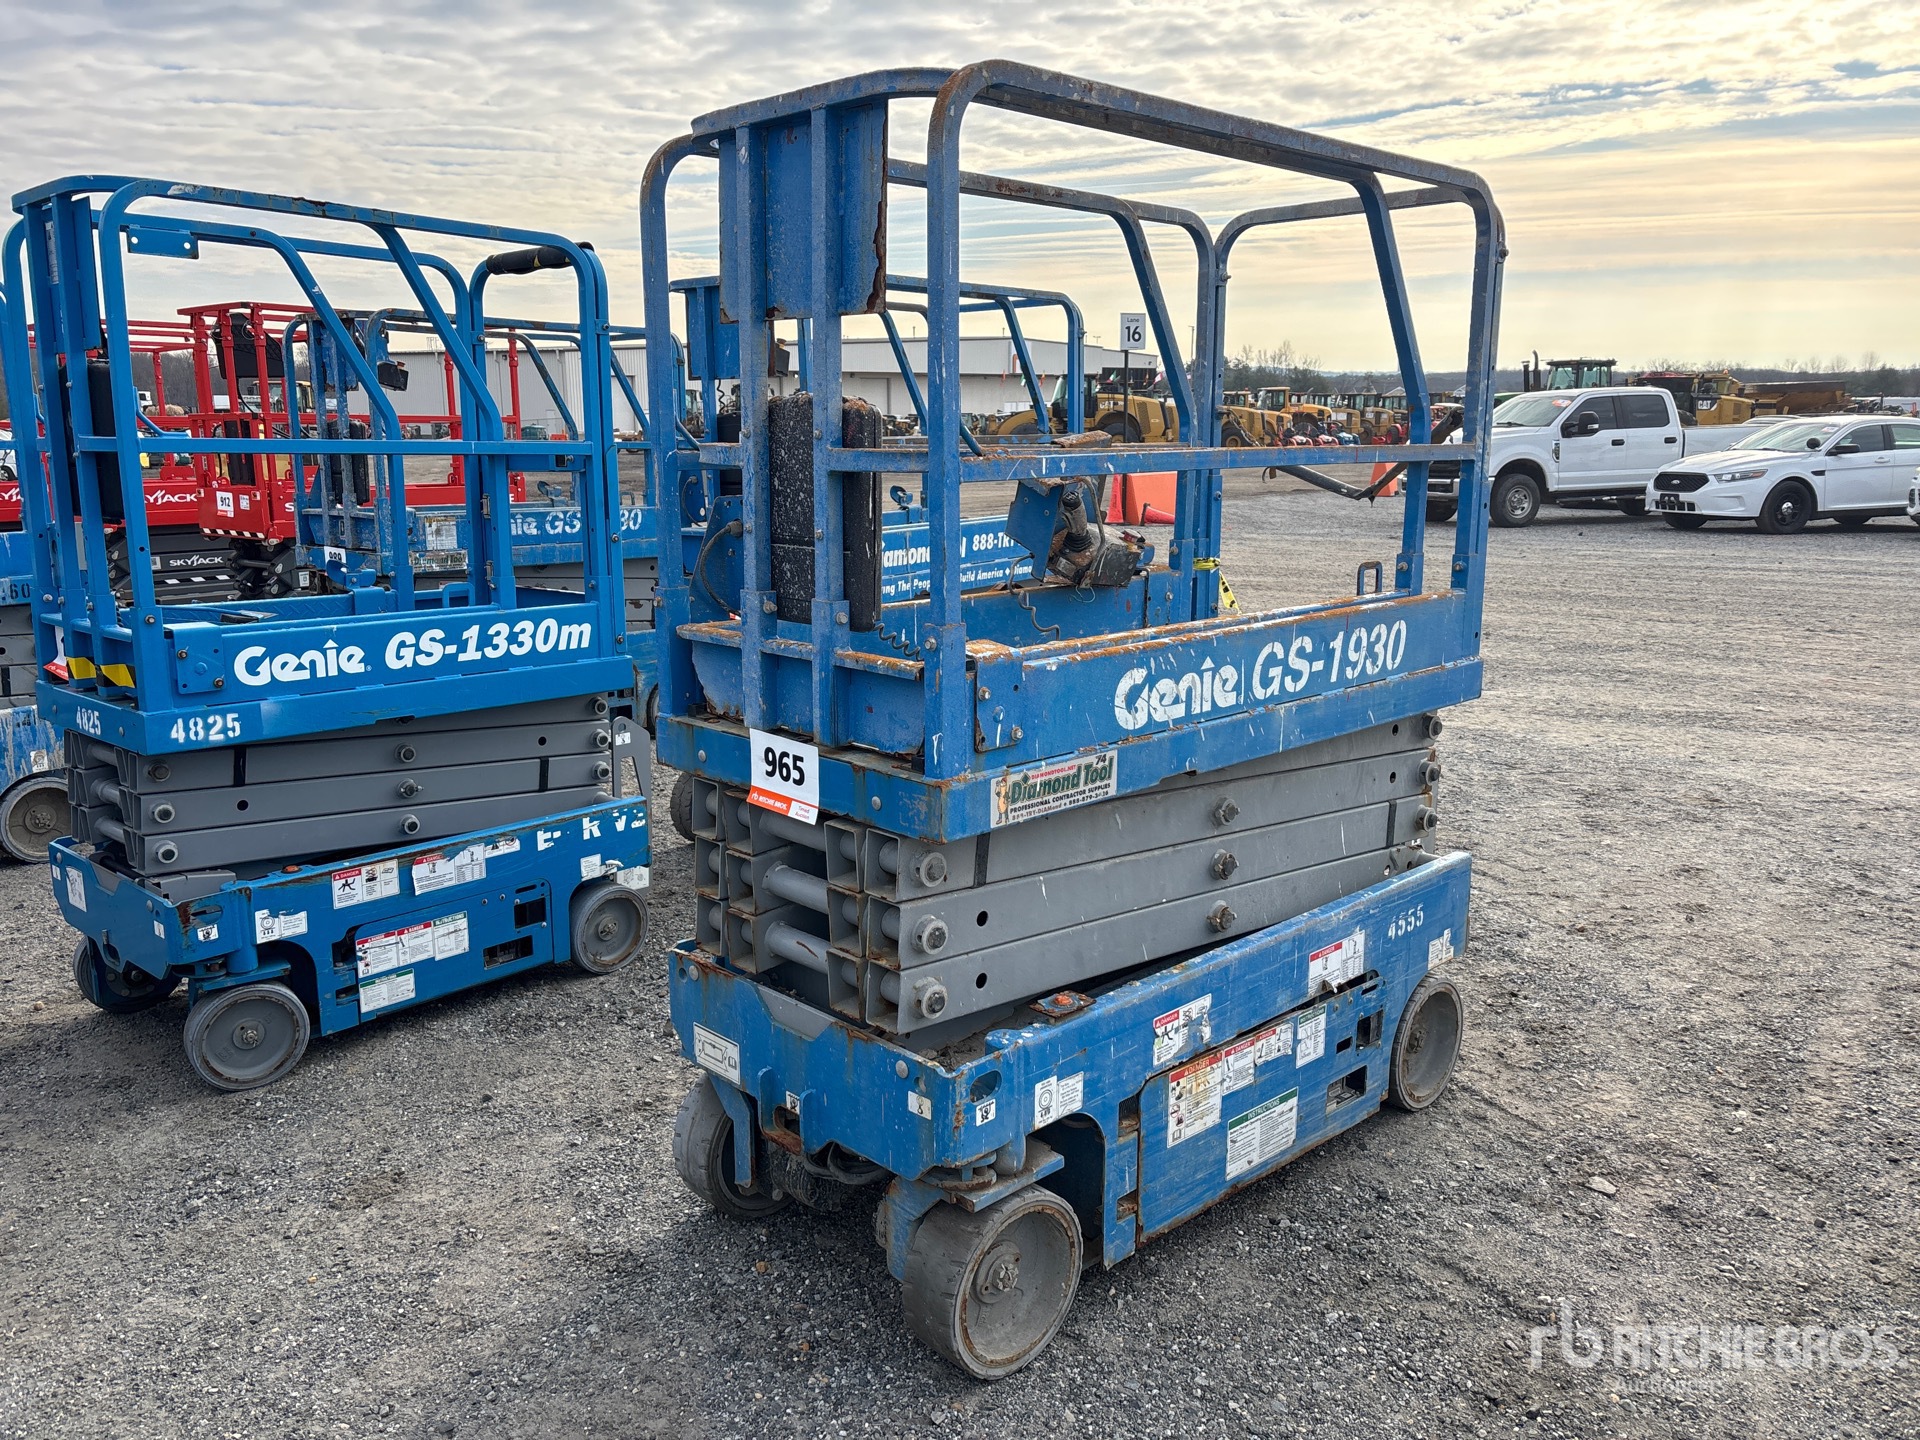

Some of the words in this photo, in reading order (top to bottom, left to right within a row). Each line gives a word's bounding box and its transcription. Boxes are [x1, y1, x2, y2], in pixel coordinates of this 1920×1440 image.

[1125, 326, 1142, 342] 16
[1698, 400, 1711, 410] CAT
[220, 496, 231, 508] 912
[169, 554, 224, 567] SKYJACK
[897, 579, 911, 592] The
[977, 567, 1004, 581] America
[234, 639, 366, 686] Genie
[385, 618, 592, 670] GS-1330m
[1114, 655, 1239, 730] Genie
[1252, 620, 1407, 700] GS-1930
[76, 705, 102, 736] 4825
[170, 713, 241, 744] 4825
[764, 746, 805, 787] 965
[1095, 753, 1107, 766] 74
[1010, 764, 1082, 805] Diamond
[1083, 756, 1115, 786] Tool
[1010, 799, 1051, 814] PROFESSIONAL
[1052, 788, 1087, 803] CONTRACTOR
[1088, 782, 1111, 794] SUPPLIES
[340, 870, 360, 879] DANGER
[1388, 902, 1425, 940] 4555
[1160, 1013, 1178, 1026] DANGER
[1235, 1041, 1251, 1052] DANGER
[1188, 1059, 1210, 1075] DANGER
[1247, 1098, 1280, 1120] INSTRUCTIONS
